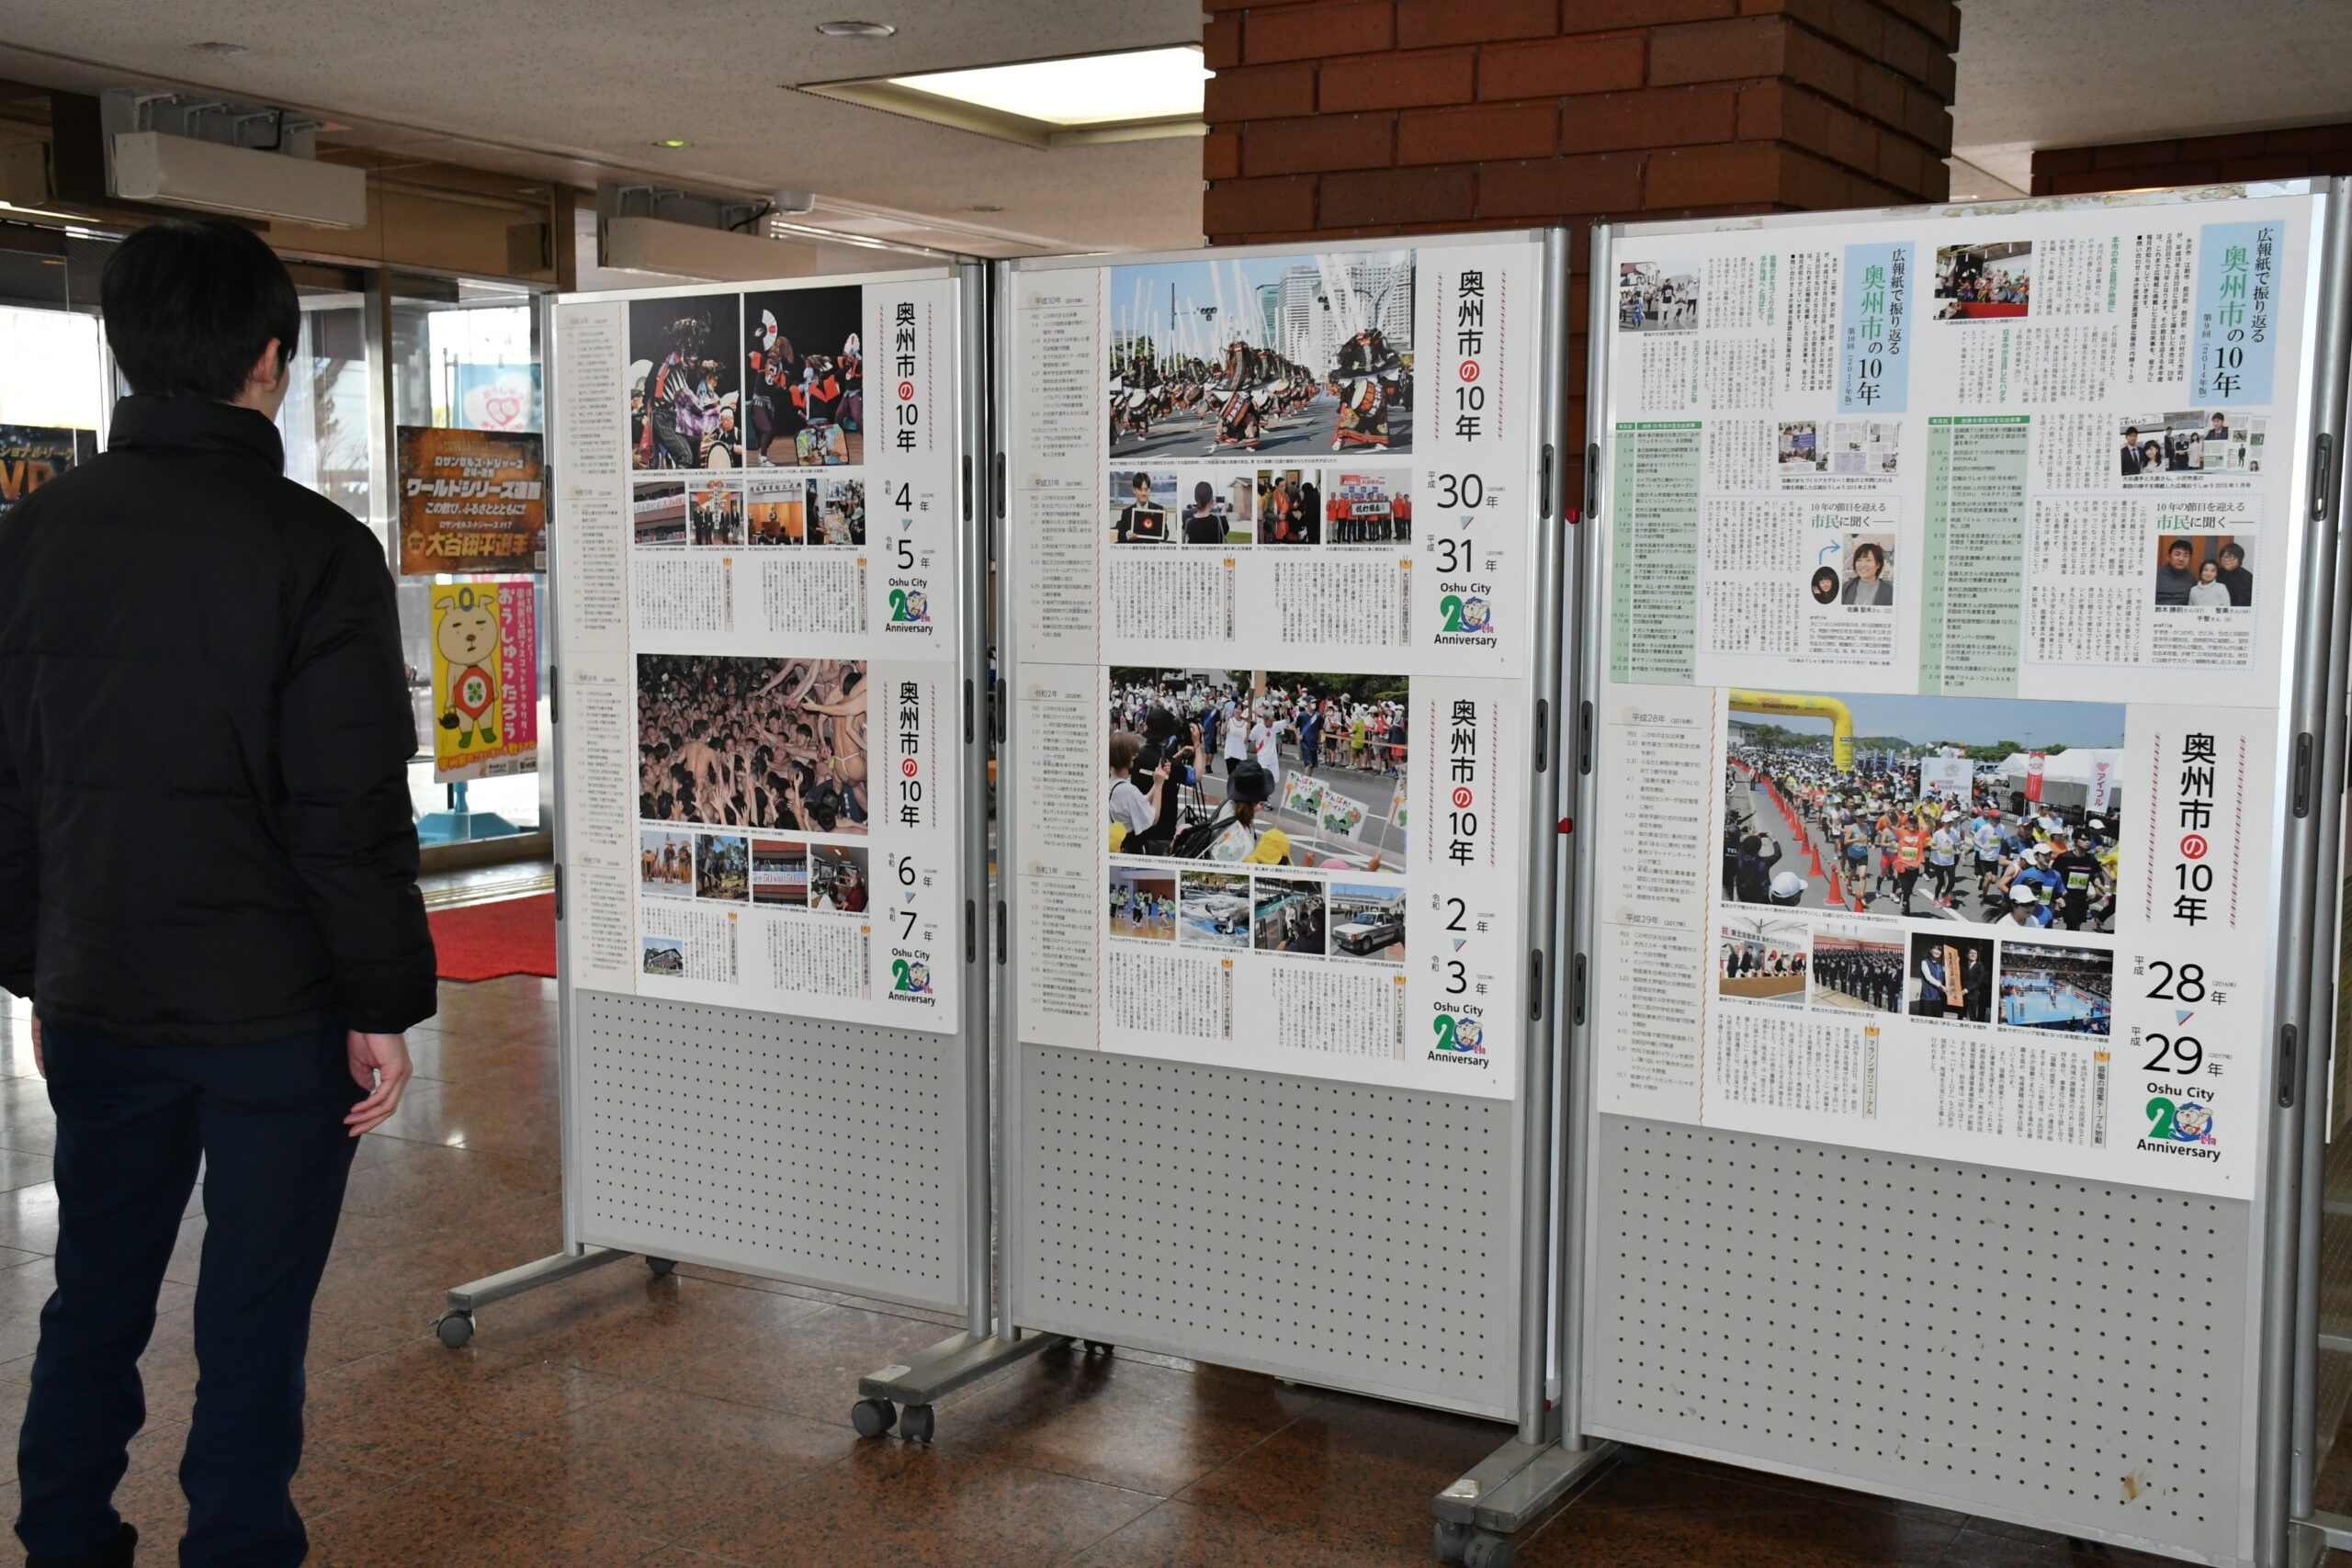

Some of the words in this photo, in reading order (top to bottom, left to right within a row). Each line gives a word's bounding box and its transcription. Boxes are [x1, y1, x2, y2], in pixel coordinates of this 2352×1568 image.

[2251, 228, 2274, 343] 広報紙で振り返る
[1888, 248, 1906, 355] 広報紙で振り返る
[1857, 265, 1886, 406] 奥州市の10年
[2212, 246, 2249, 398] 奥州市の10年
[1455, 270, 1485, 442] 奥州市の10年
[1999, 329, 2009, 403] 日本中が注目したハタチ
[896, 302, 919, 453] 奥州市の10年
[407, 479, 542, 500] ワールドシリーズ連覇
[895, 482, 912, 512] 4
[920, 502, 930, 513] 年
[1428, 471, 1436, 489] 平成
[1437, 474, 1483, 508] 30
[1487, 496, 1498, 508] 年
[1811, 502, 1886, 513] 10年の節目を迎える
[1811, 514, 1871, 530] 市民に聞く
[2156, 502, 2245, 513] 10年の節目を迎える
[2156, 514, 2226, 530] 市民に聞く
[425, 532, 529, 557] 大谷翔平選手
[898, 539, 914, 570] 5
[921, 558, 930, 569] 年
[1427, 535, 1435, 551] 平成
[1436, 538, 1472, 573] 31
[1486, 560, 1498, 572] 年
[888, 578, 910, 587] Oshu
[911, 578, 928, 588] City
[1441, 582, 1467, 592] Oshu
[1470, 582, 1491, 594] City
[885, 623, 933, 636] Anniversary
[1434, 634, 1498, 649] Anniversary
[498, 587, 517, 739] おうしゅうたろう
[1632, 713, 1666, 723] 平成28年
[899, 682, 922, 828] 奥州市の10年
[1449, 699, 1477, 866] 奥州市の10年
[2094, 773, 2107, 807] アイフル
[2173, 732, 2217, 927] 奥州市の10年
[899, 856, 916, 886] 6
[923, 876, 933, 888] 年
[900, 911, 917, 940] 7
[923, 931, 933, 942] 年
[1432, 894, 1440, 910] 令和
[1445, 897, 1466, 931] 2
[1476, 921, 1488, 933] 年
[1625, 913, 1658, 923] 平成29年
[891, 948, 912, 958] Oshu
[914, 950, 931, 961] City
[1431, 955, 1440, 972] 令和
[1446, 961, 1467, 994] 3
[1476, 983, 1487, 996] 年
[2133, 956, 2144, 976] 平成
[2145, 961, 2205, 1002] 28
[2211, 991, 2227, 1005] 年
[888, 991, 936, 1007] Anniversary
[1433, 1001, 1460, 1012] Oshu
[1463, 1004, 1483, 1016] City
[1428, 1050, 1489, 1069] Anniversary
[2130, 1027, 2141, 1046] 平成
[2142, 1033, 2202, 1075] 29
[2207, 1062, 2223, 1077] 年
[1866, 1040, 1876, 1115] マラソンがリニューアル
[2147, 1082, 2182, 1096] Oshu
[2187, 1087, 2214, 1102] City
[2137, 1139, 2221, 1162] Anniversary
